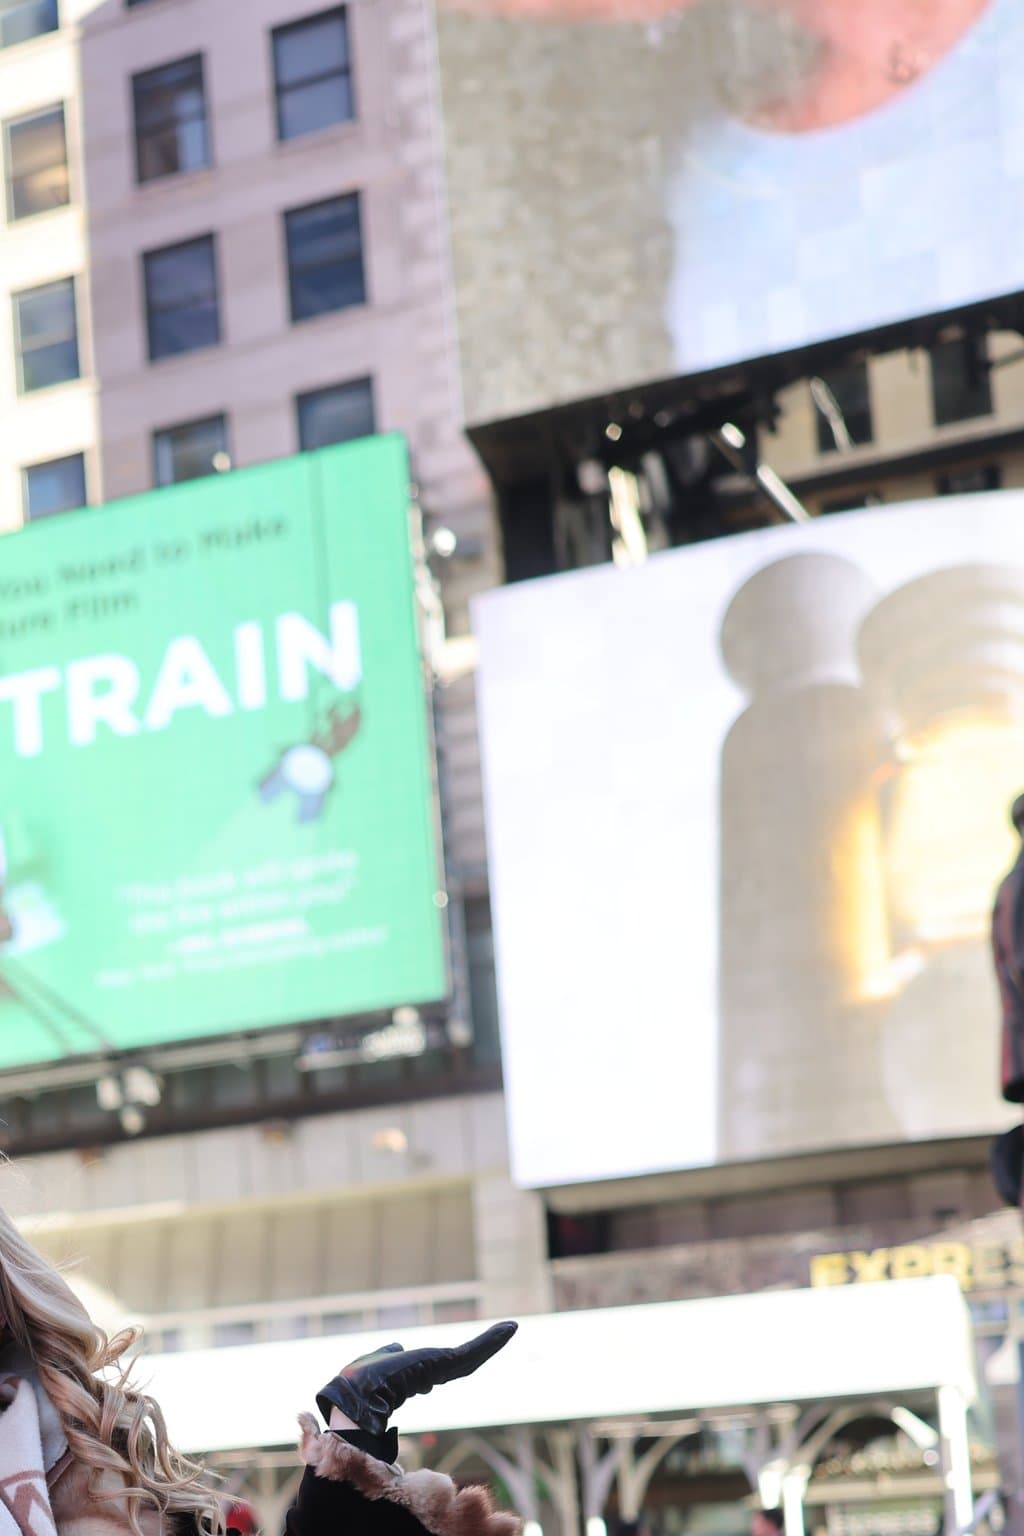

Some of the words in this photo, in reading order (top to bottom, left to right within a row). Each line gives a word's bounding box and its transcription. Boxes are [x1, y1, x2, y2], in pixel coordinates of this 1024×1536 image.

[57, 549, 144, 583] Need
[154, 539, 189, 566] to
[198, 517, 289, 549] Make
[64, 590, 142, 623] Film
[809, 1240, 1024, 1291] EXPRE
